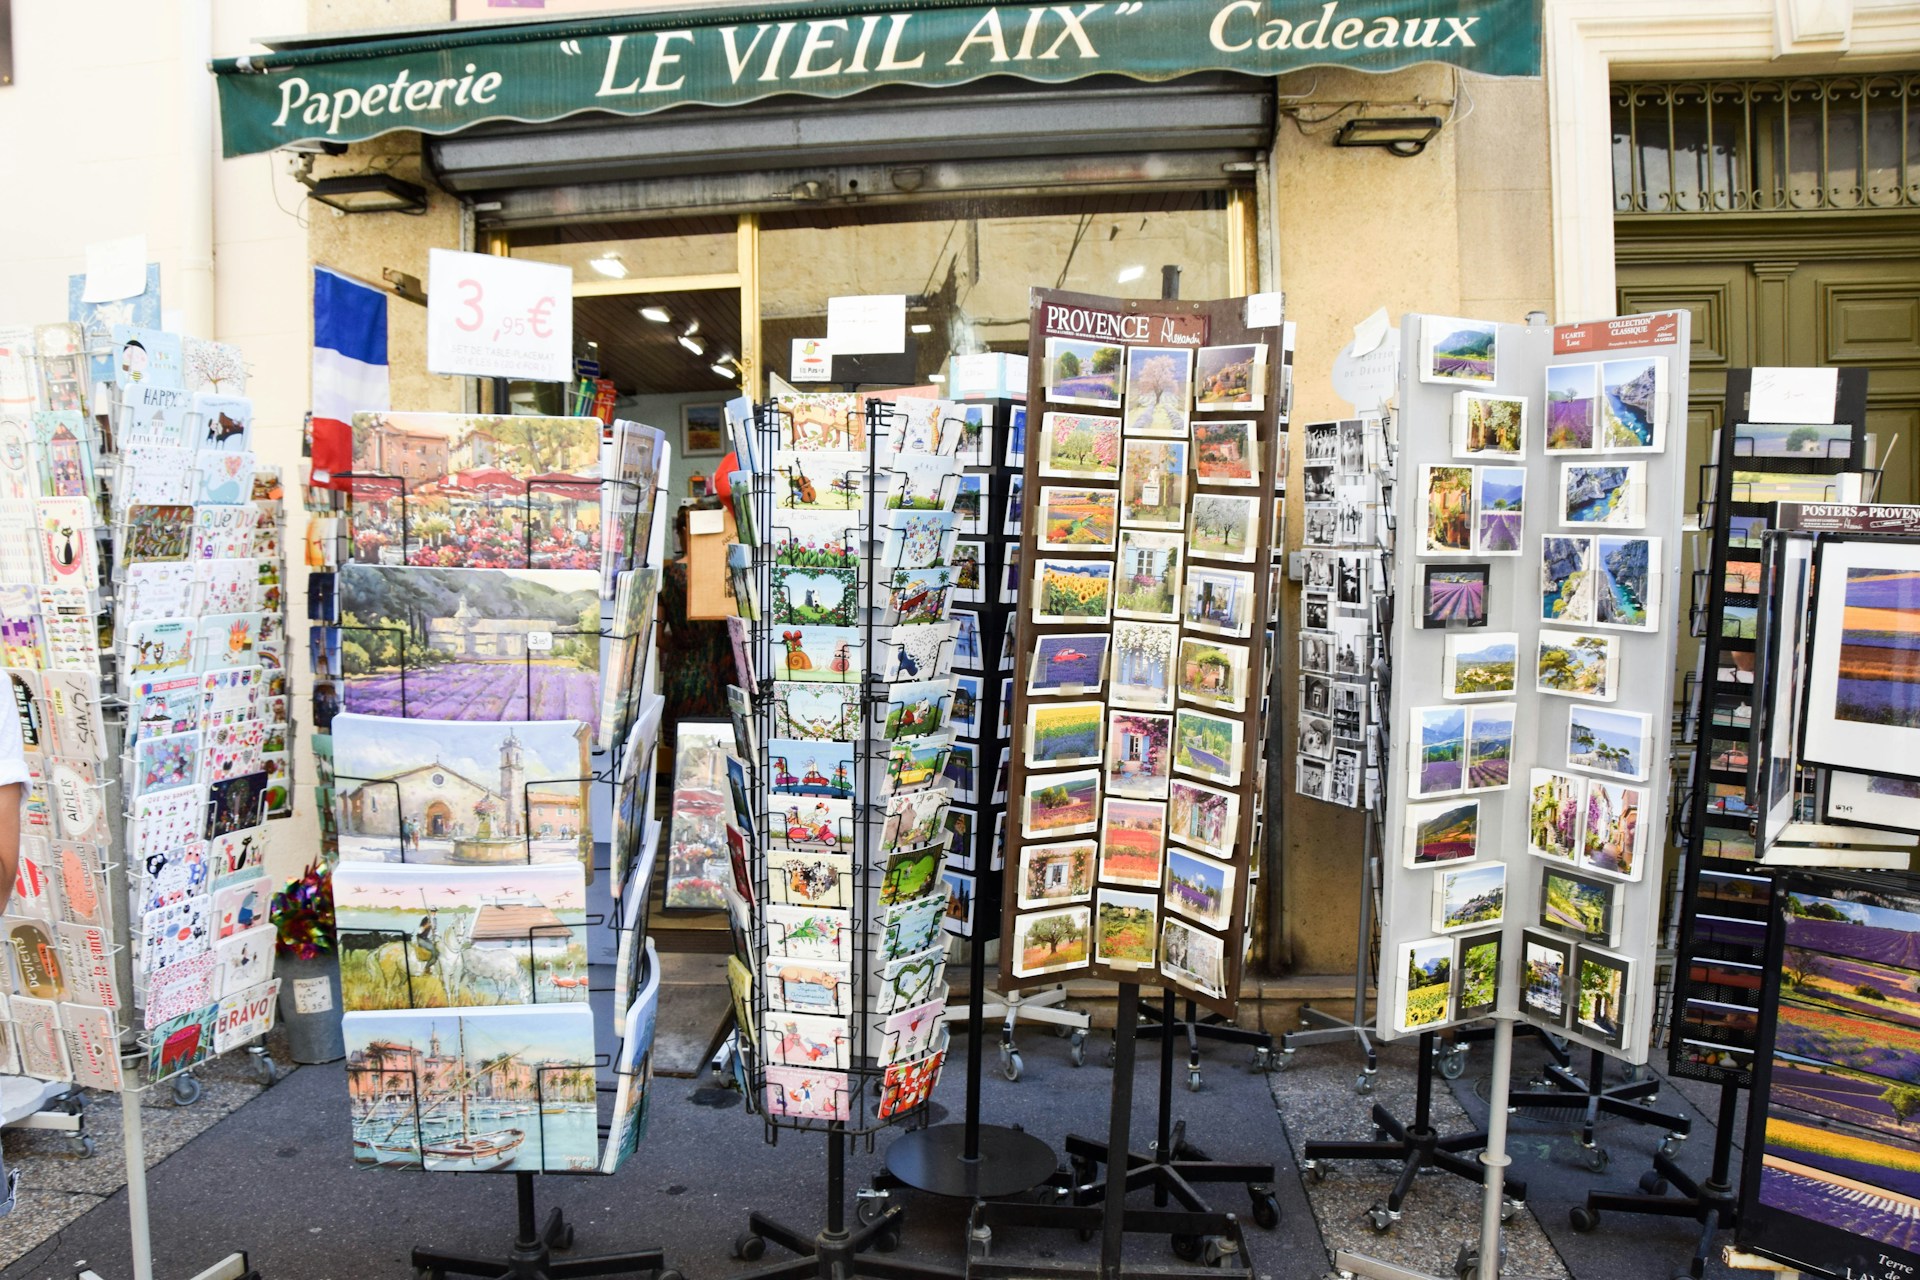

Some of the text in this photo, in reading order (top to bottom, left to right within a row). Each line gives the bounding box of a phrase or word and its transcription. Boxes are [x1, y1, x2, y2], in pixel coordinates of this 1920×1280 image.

[1208, 1, 1480, 53] Cadeaux
[718, 10, 925, 84] VIEIL
[272, 63, 503, 135] Papeterie
[1046, 305, 1151, 340] PROVENCE
[1565, 331, 1586, 339] CARTE
[1608, 318, 1651, 329] COLLECTION
[1611, 325, 1648, 337] CLASSIQUE
[1802, 504, 1858, 518] POSTERS
[1868, 507, 1920, 520] PROVEN
[22, 717, 35, 744] POUR
[217, 997, 269, 1035] BRAVO
[1877, 1253, 1914, 1275] Terre
